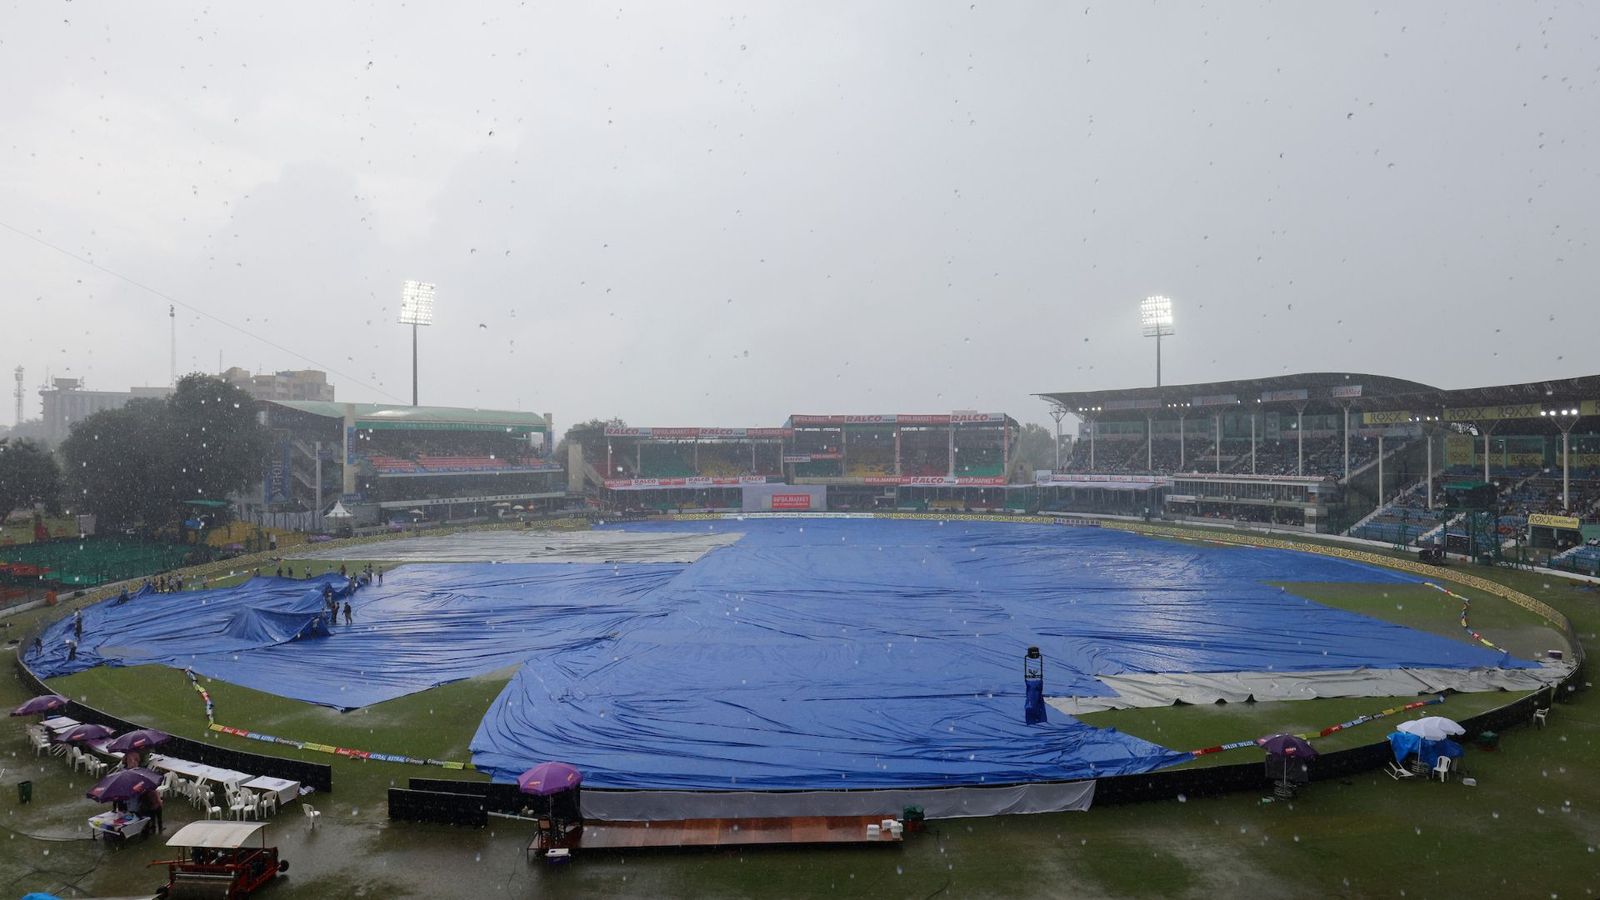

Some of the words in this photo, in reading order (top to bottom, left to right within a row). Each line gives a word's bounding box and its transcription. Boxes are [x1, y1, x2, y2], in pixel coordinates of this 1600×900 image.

[1371, 412, 1401, 422] ROXX
[1449, 408, 1485, 419] ROXX
[1497, 406, 1534, 417] ROXX
[1530, 515, 1553, 525] ROXX
[369, 753, 386, 761] ASTRAL
[387, 755, 405, 763] ASTRAL
